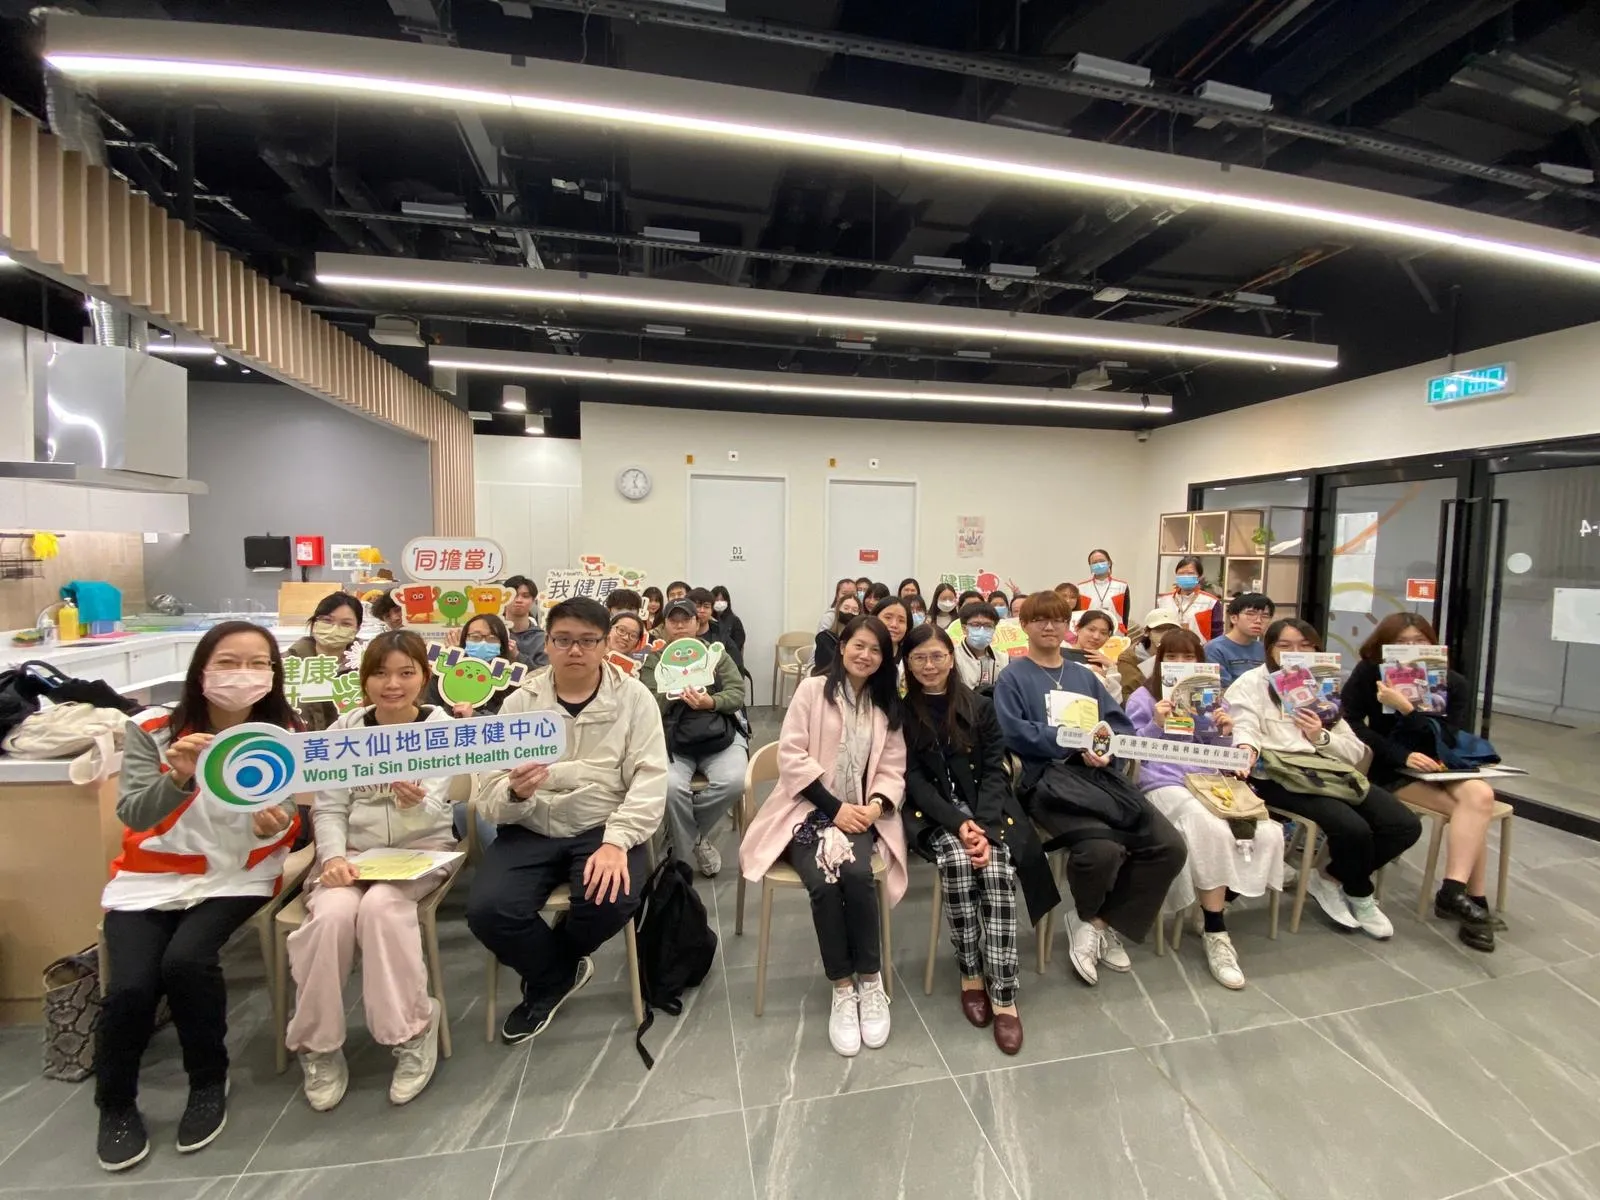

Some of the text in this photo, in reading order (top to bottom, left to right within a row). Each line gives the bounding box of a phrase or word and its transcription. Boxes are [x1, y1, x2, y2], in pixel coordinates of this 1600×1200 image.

[303, 717, 557, 763] 黃大仙地區康健中心
[303, 744, 557, 783] Wong Tai Sin District Health Centre
